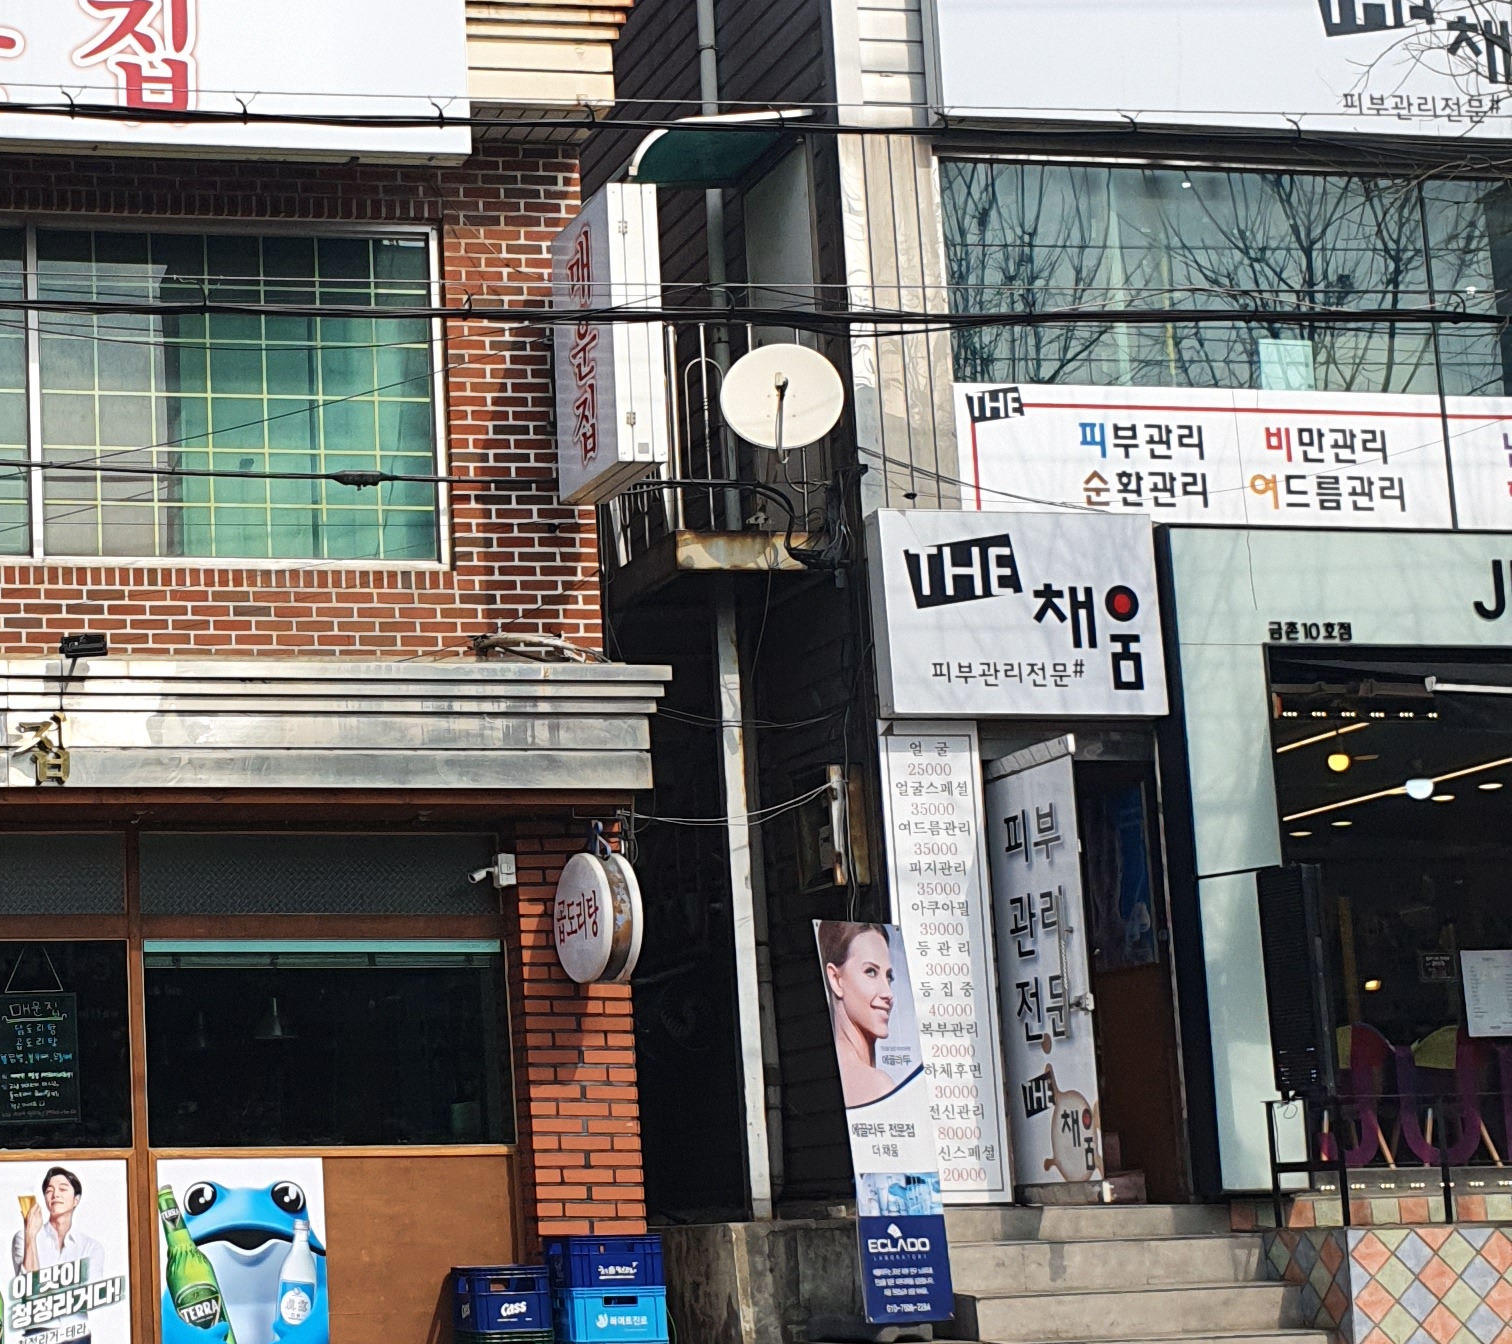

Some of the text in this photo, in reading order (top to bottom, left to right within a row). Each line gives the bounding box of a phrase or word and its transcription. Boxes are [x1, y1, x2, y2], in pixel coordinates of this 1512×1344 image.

[567, 228, 600, 457] 매운집
[966, 386, 1025, 423] THE
[1078, 422, 1388, 464] 피부관리 비만관리
[1083, 470, 1406, 512] 순환관리 여드름관리
[904, 534, 1023, 609] THE
[1033, 583, 1145, 690] 채움
[907, 762, 952, 777] 25000
[895, 780, 969, 798] 얼굴스페셜
[910, 802, 955, 816] 35000
[898, 819, 972, 837] 여드름관리
[1004, 802, 1062, 863] 피부
[913, 842, 958, 856] 35000
[908, 859, 968, 877] 피지관리
[916, 881, 961, 896] 35000
[911, 899, 970, 917] 아쿠아필
[556, 889, 599, 946] 곱도리탕
[1009, 884, 1064, 958] 관리
[919, 921, 964, 936] 39000
[925, 962, 970, 977] 30000
[928, 1003, 973, 1018] 40000
[919, 1021, 979, 1039] 복부관리
[931, 1043, 976, 1058] 20000
[923, 1062, 983, 1080] 하체후면
[934, 1084, 979, 1099] 30000
[929, 1104, 985, 1120] 전신관리
[888, 1122, 916, 1138] 전문점
[937, 1125, 982, 1140] 80000
[938, 1144, 996, 1162] 신스페셜
[943, 1167, 987, 1182] 20000
[867, 1237, 931, 1253] ECLADO
[12, 1259, 81, 1299] 이 맛이
[11, 1277, 122, 1329] 청정라거다!
[180, 1299, 220, 1323] TERRA
[500, 1301, 527, 1317] Cass
